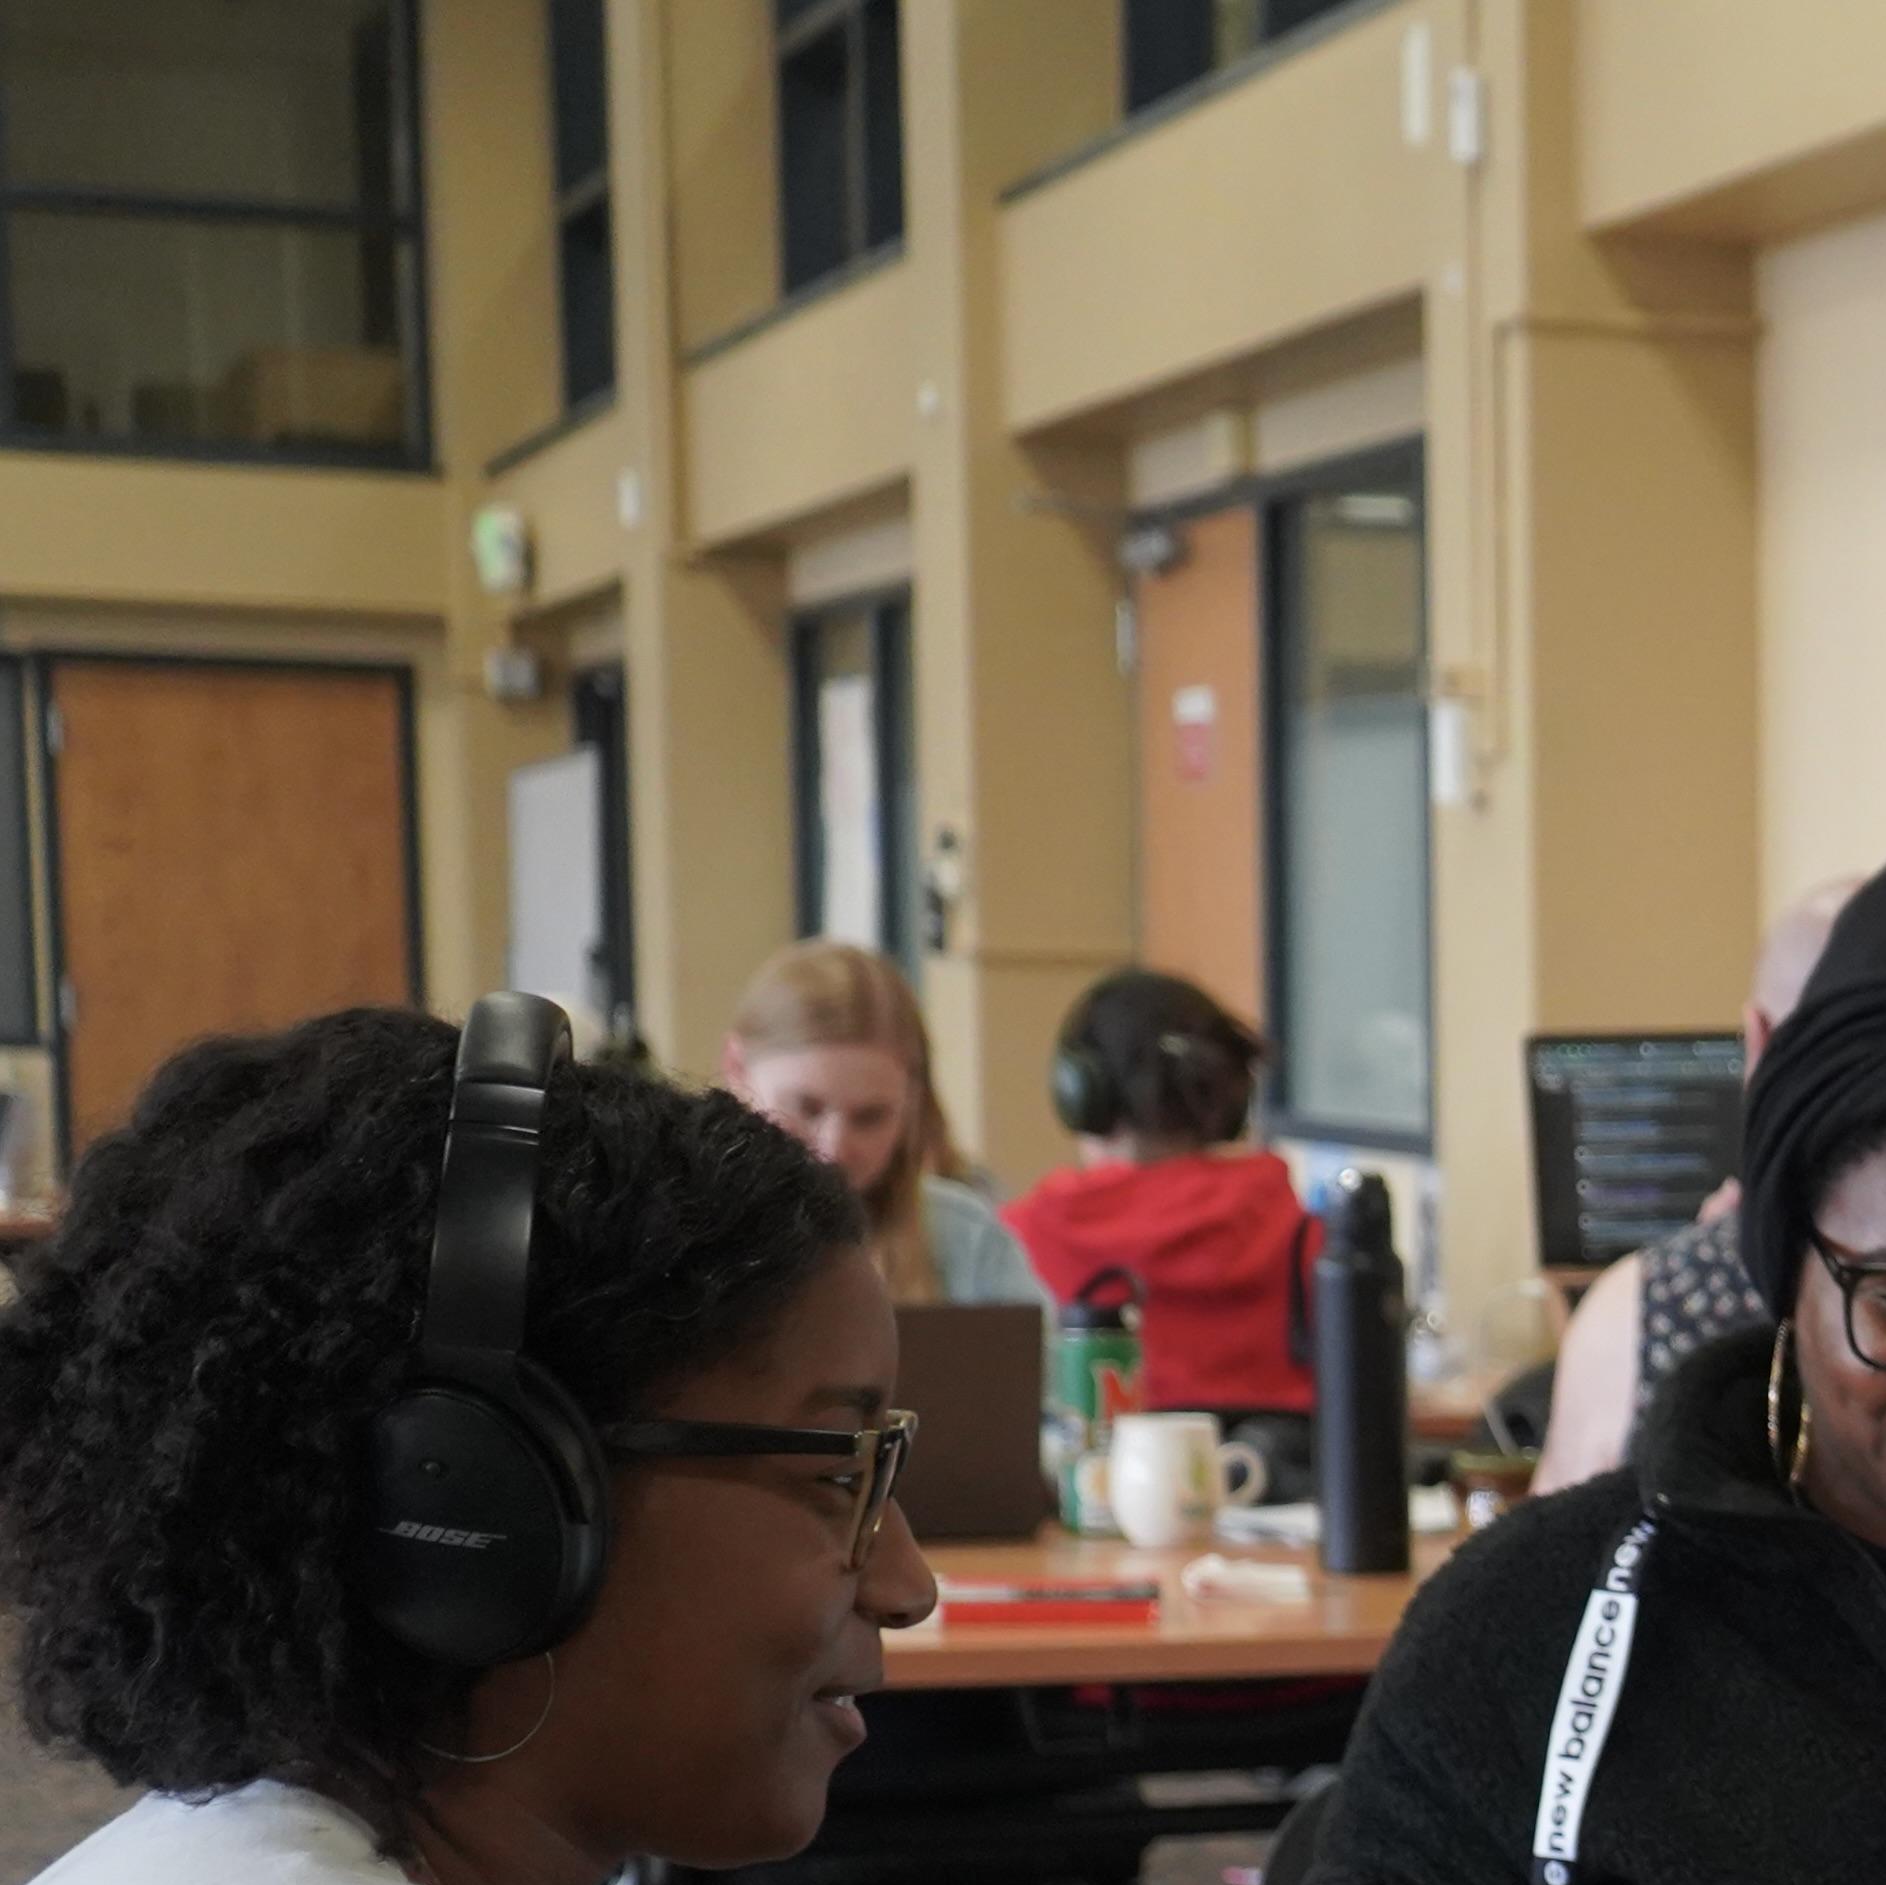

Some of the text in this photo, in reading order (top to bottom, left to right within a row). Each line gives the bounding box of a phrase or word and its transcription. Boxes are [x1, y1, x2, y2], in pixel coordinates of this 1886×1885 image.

[376, 1520, 507, 1550] BOSE
[1558, 1599, 1621, 1759] balance
[1547, 1770, 1575, 1852] new
